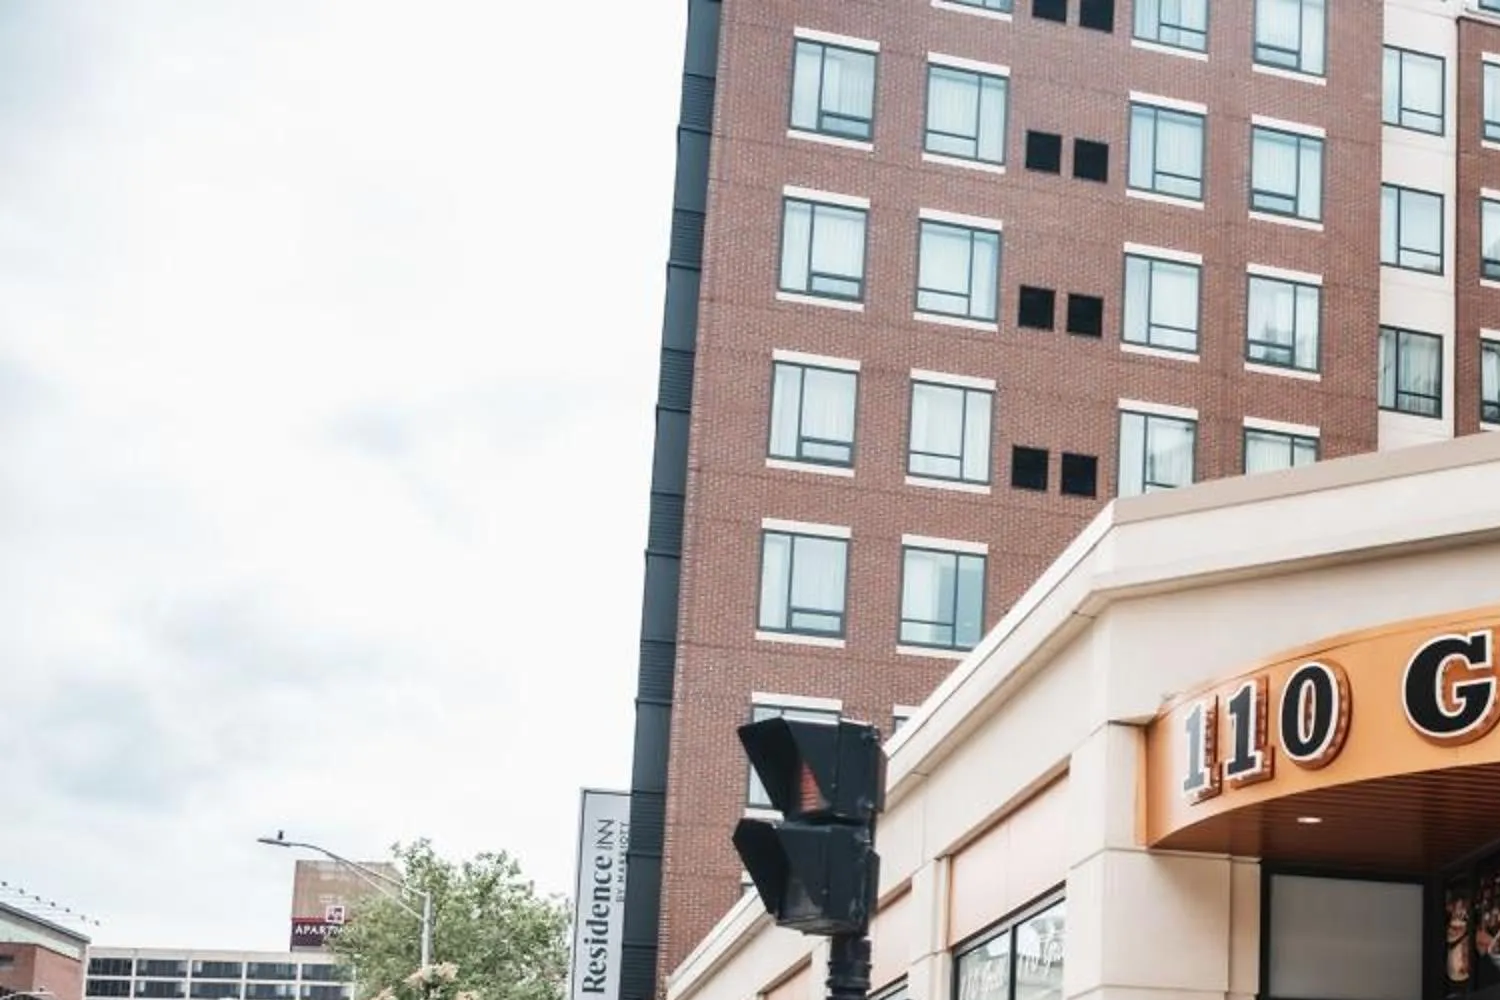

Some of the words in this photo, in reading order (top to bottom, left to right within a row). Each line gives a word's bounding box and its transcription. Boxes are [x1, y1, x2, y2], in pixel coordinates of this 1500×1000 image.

[1182, 659, 1342, 794] 110
[596, 818, 615, 851] INN
[581, 855, 613, 994] Residence
